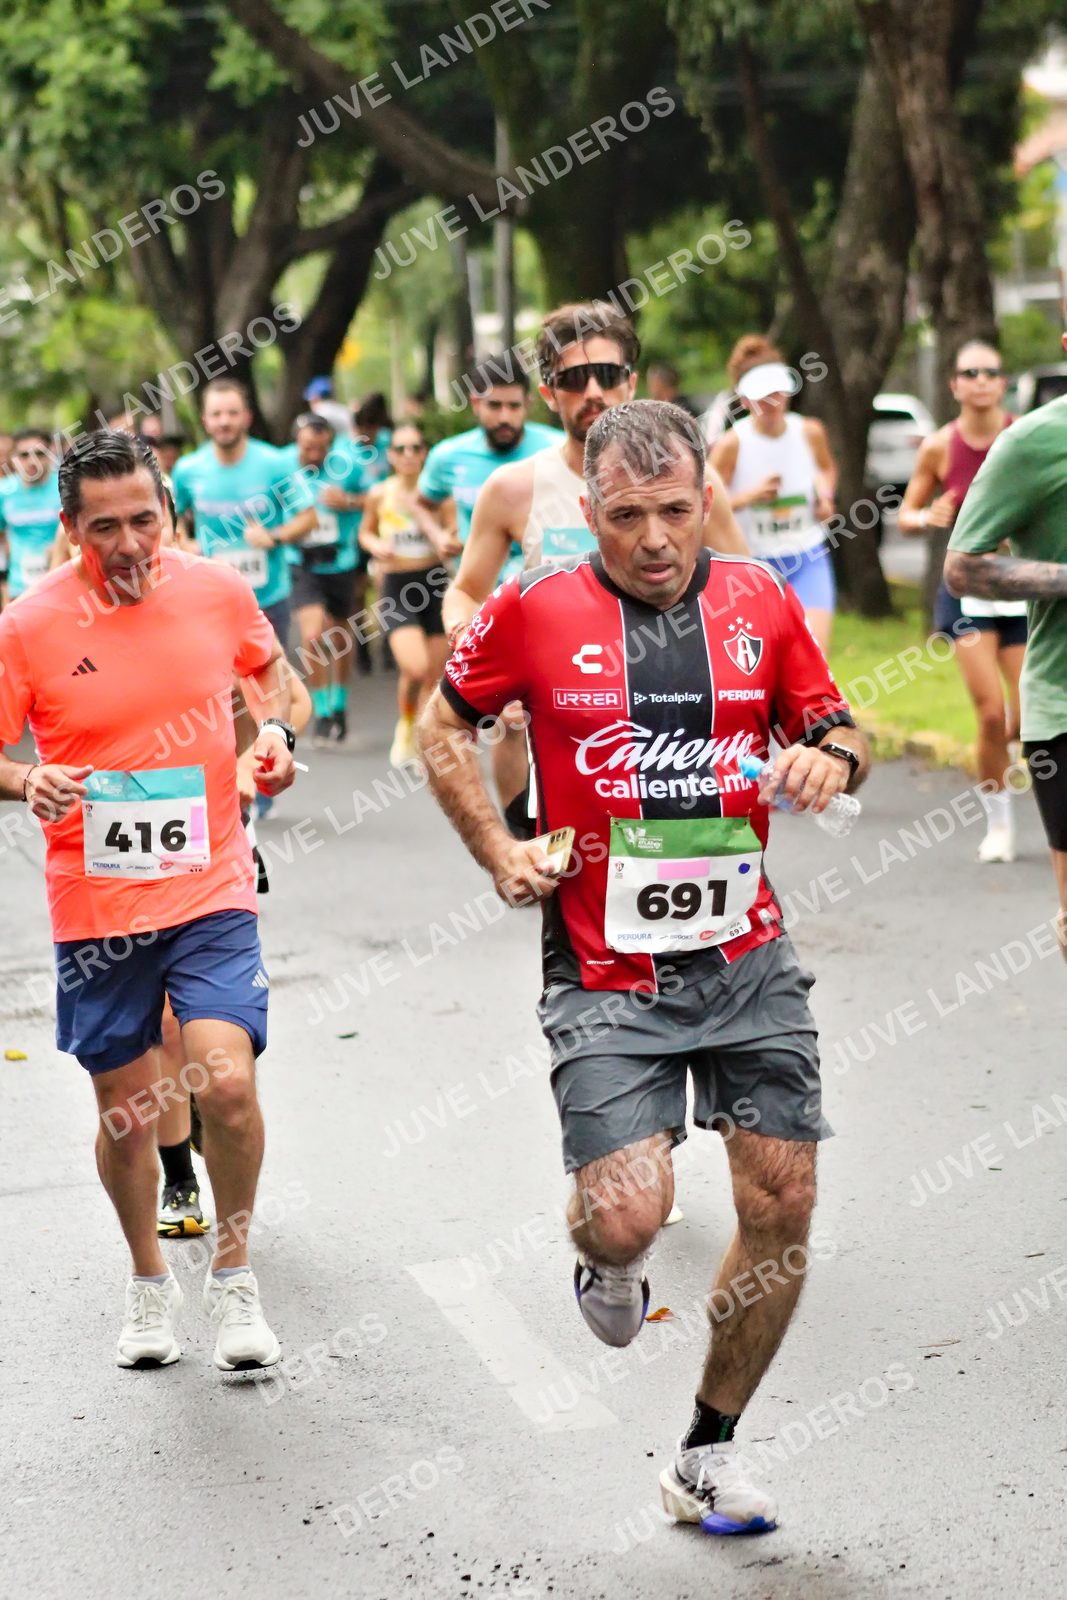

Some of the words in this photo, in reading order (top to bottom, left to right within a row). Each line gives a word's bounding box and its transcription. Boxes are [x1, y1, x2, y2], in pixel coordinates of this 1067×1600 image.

[556, 693, 618, 707] URREA
[648, 692, 703, 704] Totalplay
[570, 719, 757, 776] Caliente
[104, 819, 187, 853] 416
[636, 880, 728, 921] 691
[729, 926, 745, 938] 691
